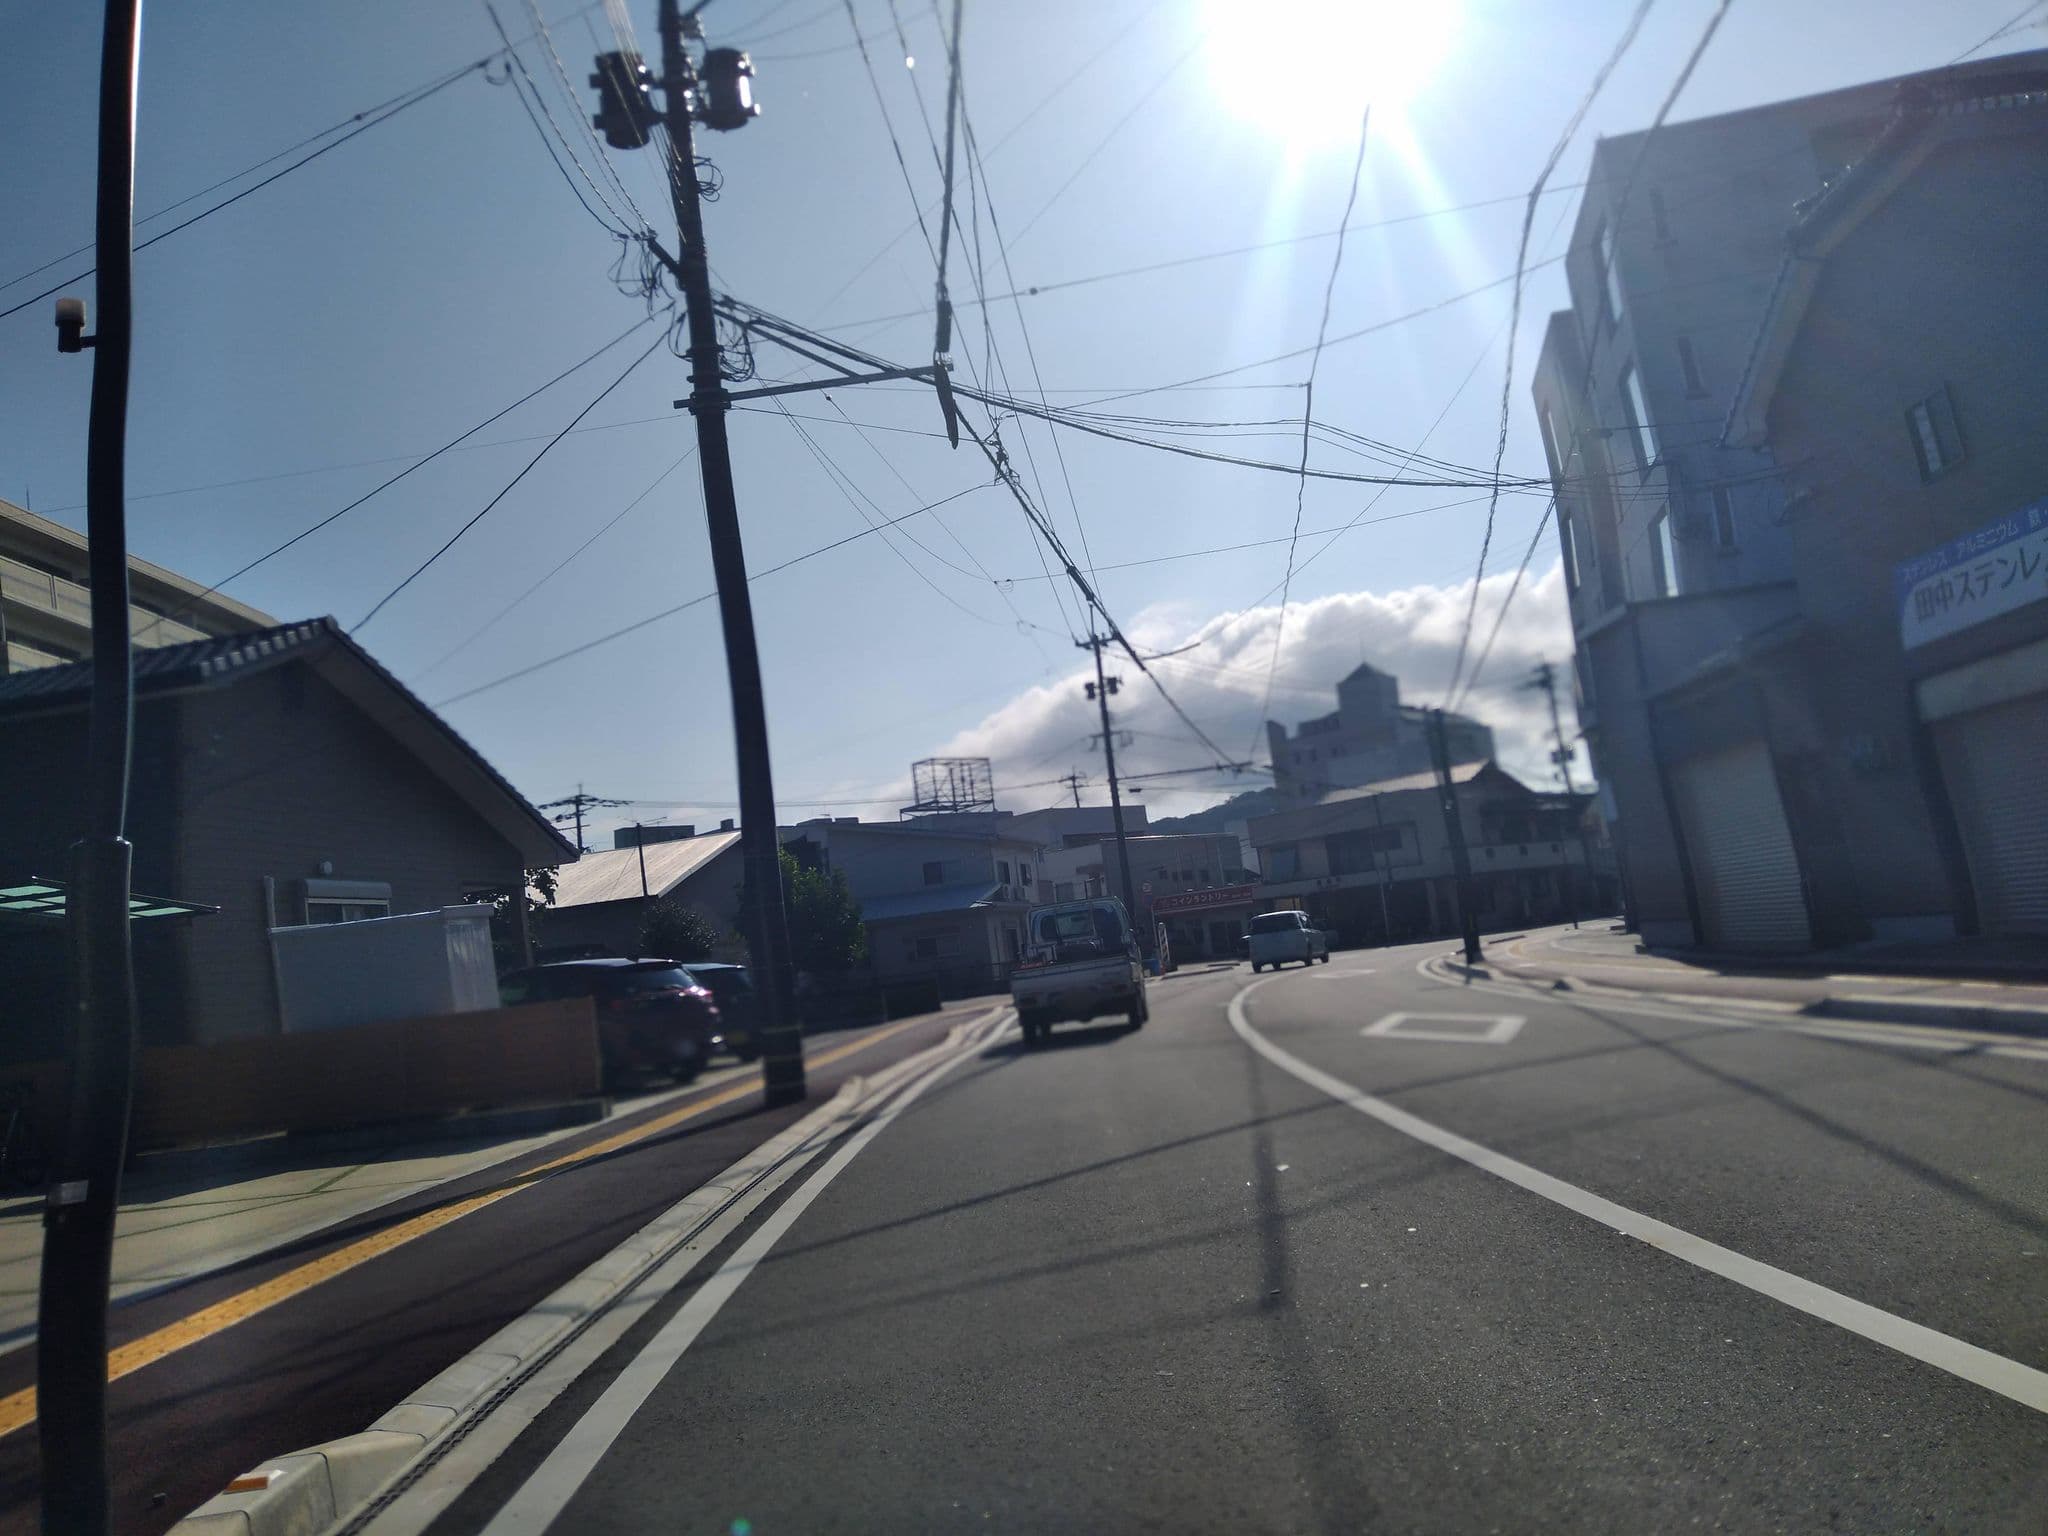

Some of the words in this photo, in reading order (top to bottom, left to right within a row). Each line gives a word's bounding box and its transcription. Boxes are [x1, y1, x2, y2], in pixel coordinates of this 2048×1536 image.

[1914, 547, 2048, 624] 田中ステンレ
